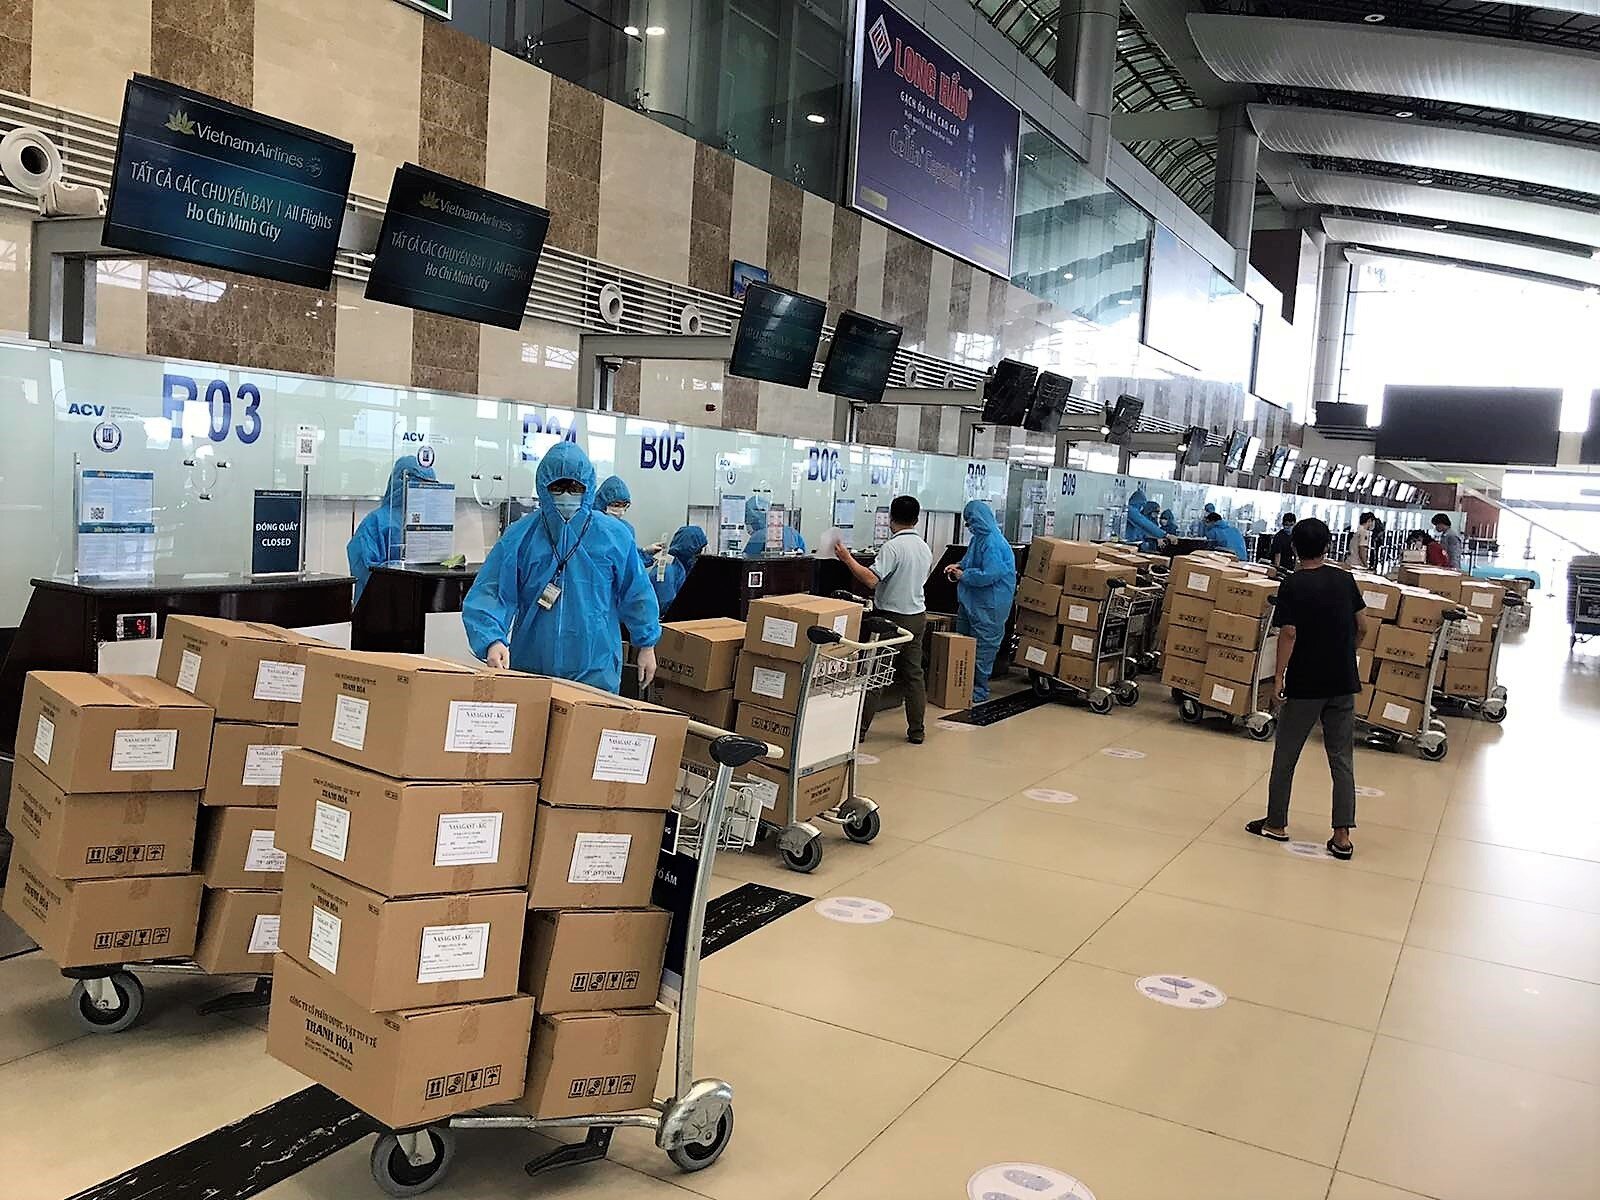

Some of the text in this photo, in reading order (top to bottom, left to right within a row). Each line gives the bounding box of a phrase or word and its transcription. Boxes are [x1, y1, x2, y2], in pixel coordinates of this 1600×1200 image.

[894, 37, 937, 100] LONG
[131, 160, 333, 231] TẤT CẢ CÁC CHUYẾN BAY All Flights
[186, 201, 281, 243] Ho Chi Minh City
[420, 239, 438, 257] CÁC
[425, 261, 491, 292] Ho Chi Minh City
[69, 403, 105, 417] ACV
[402, 432, 425, 442] ACV
[640, 427, 685, 472] B05
[1061, 472, 1077, 496] B09
[255, 521, 278, 531] ĐÓNG
[261, 538, 292, 547] CLOSED
[305, 1018, 334, 1043] THANH
[335, 1033, 354, 1055] HÓA
